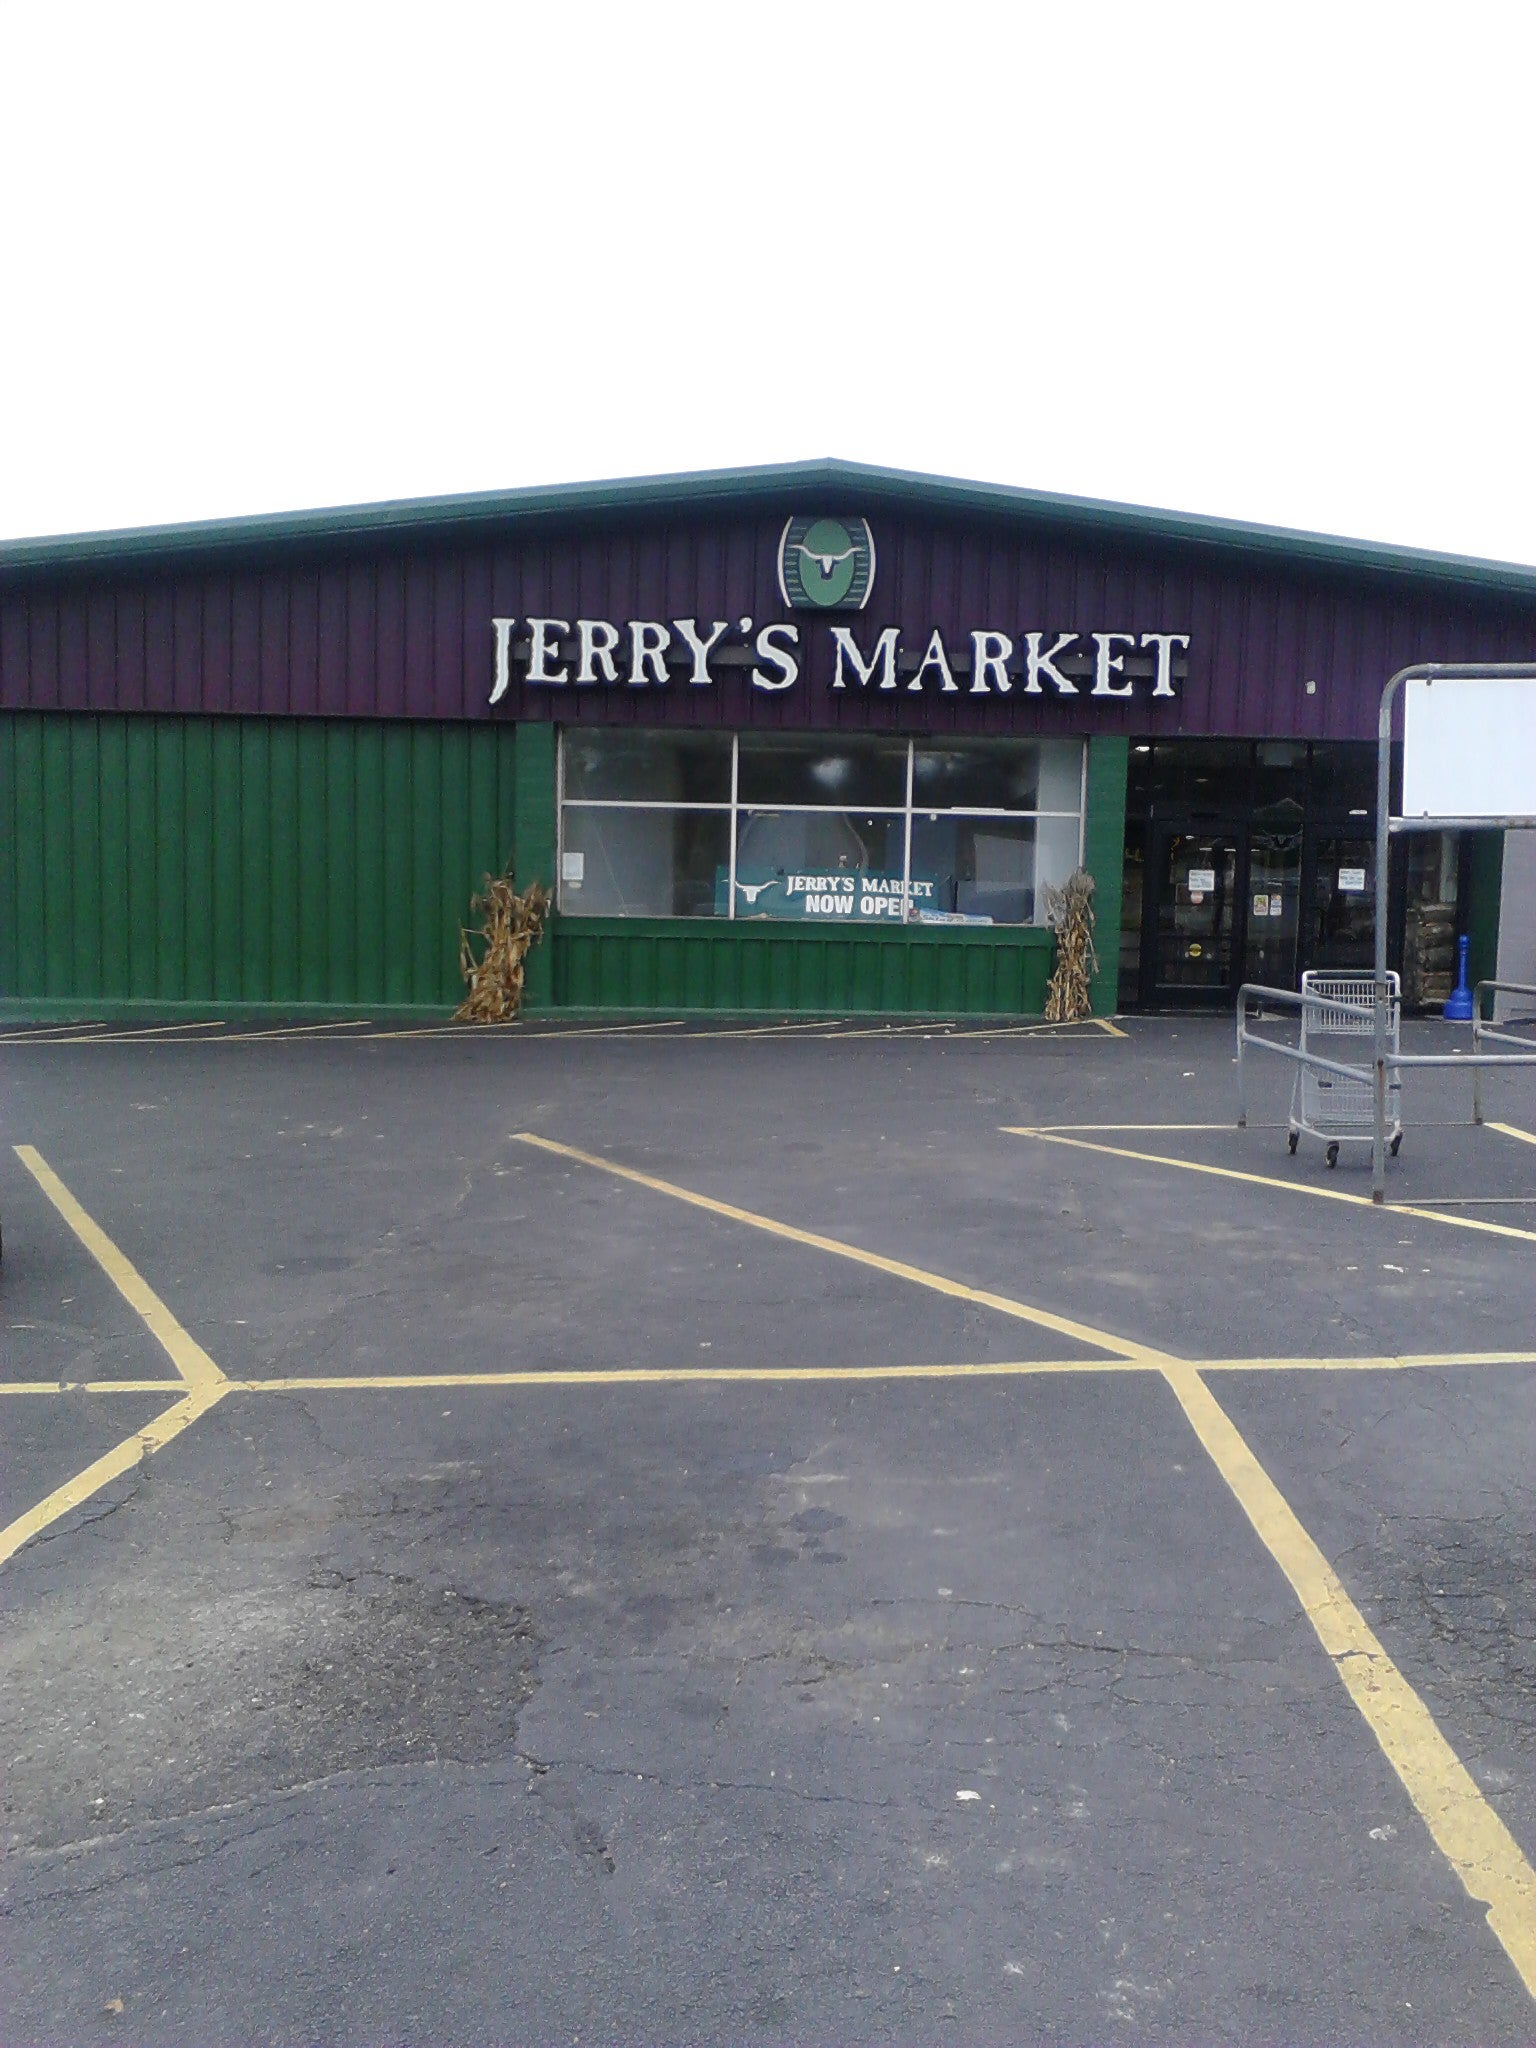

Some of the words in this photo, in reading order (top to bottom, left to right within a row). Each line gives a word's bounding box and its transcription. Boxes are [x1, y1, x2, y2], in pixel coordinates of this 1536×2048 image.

[489, 617, 799, 704] JERRY'S
[830, 627, 1190, 696] MARKET
[786, 875, 854, 896] JERRY'S
[805, 894, 853, 913] NOW
